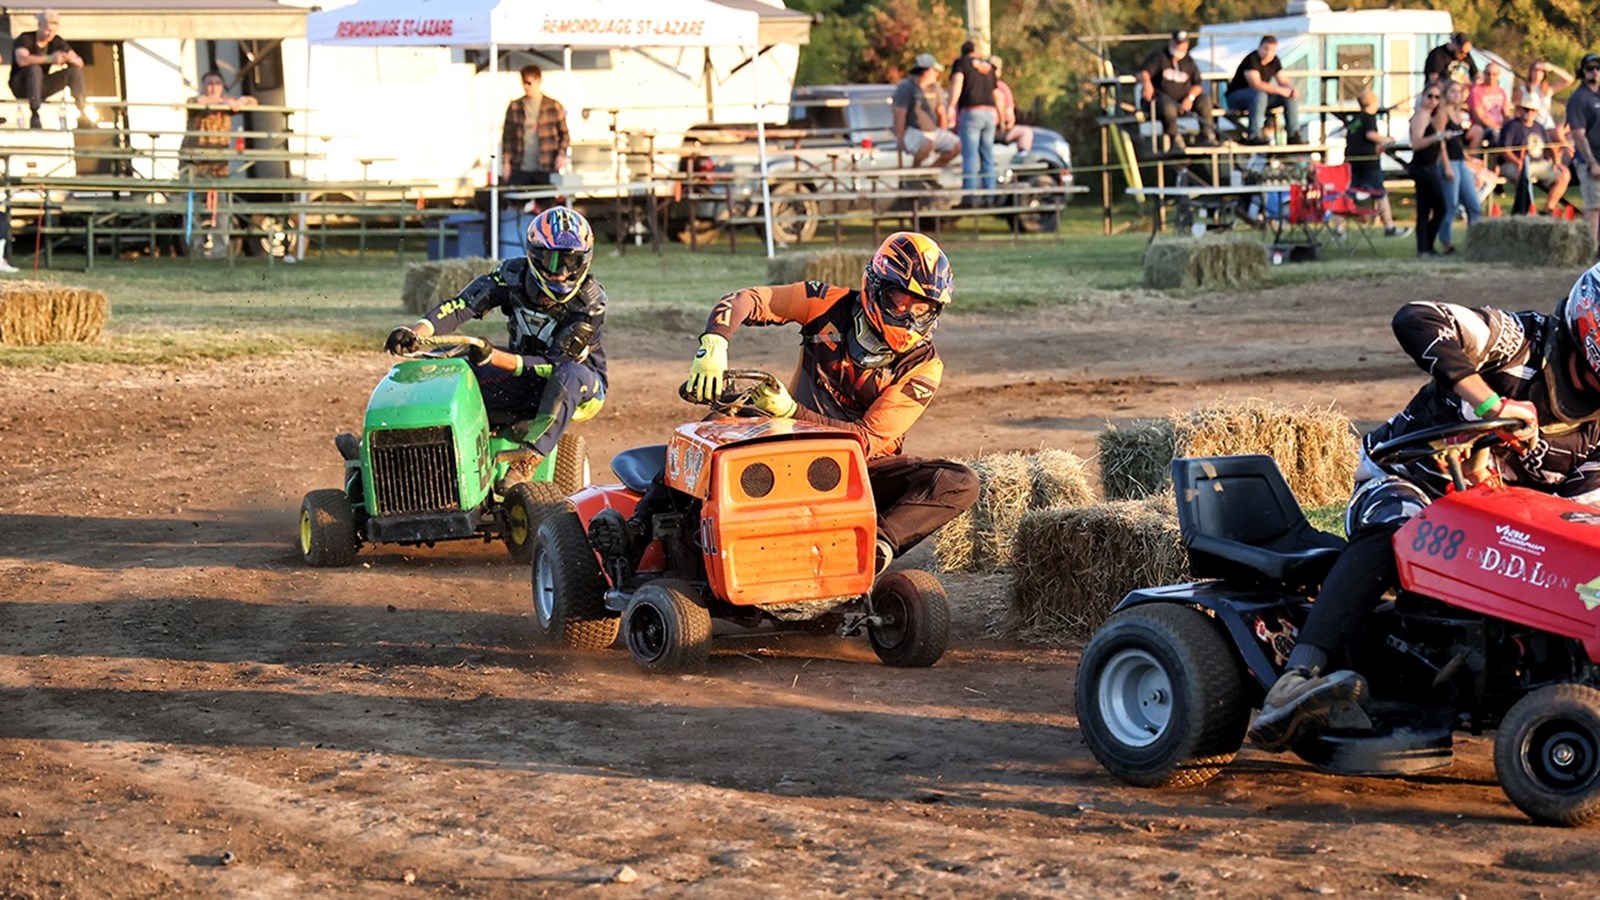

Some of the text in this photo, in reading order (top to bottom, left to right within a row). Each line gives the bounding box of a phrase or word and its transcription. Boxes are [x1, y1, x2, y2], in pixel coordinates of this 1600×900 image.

[336, 20, 399, 38] REMORQUAGE
[540, 18, 633, 34] REMORQUAGE
[1412, 520, 1466, 561] 888
[1480, 546, 1550, 590] D.D.L.
